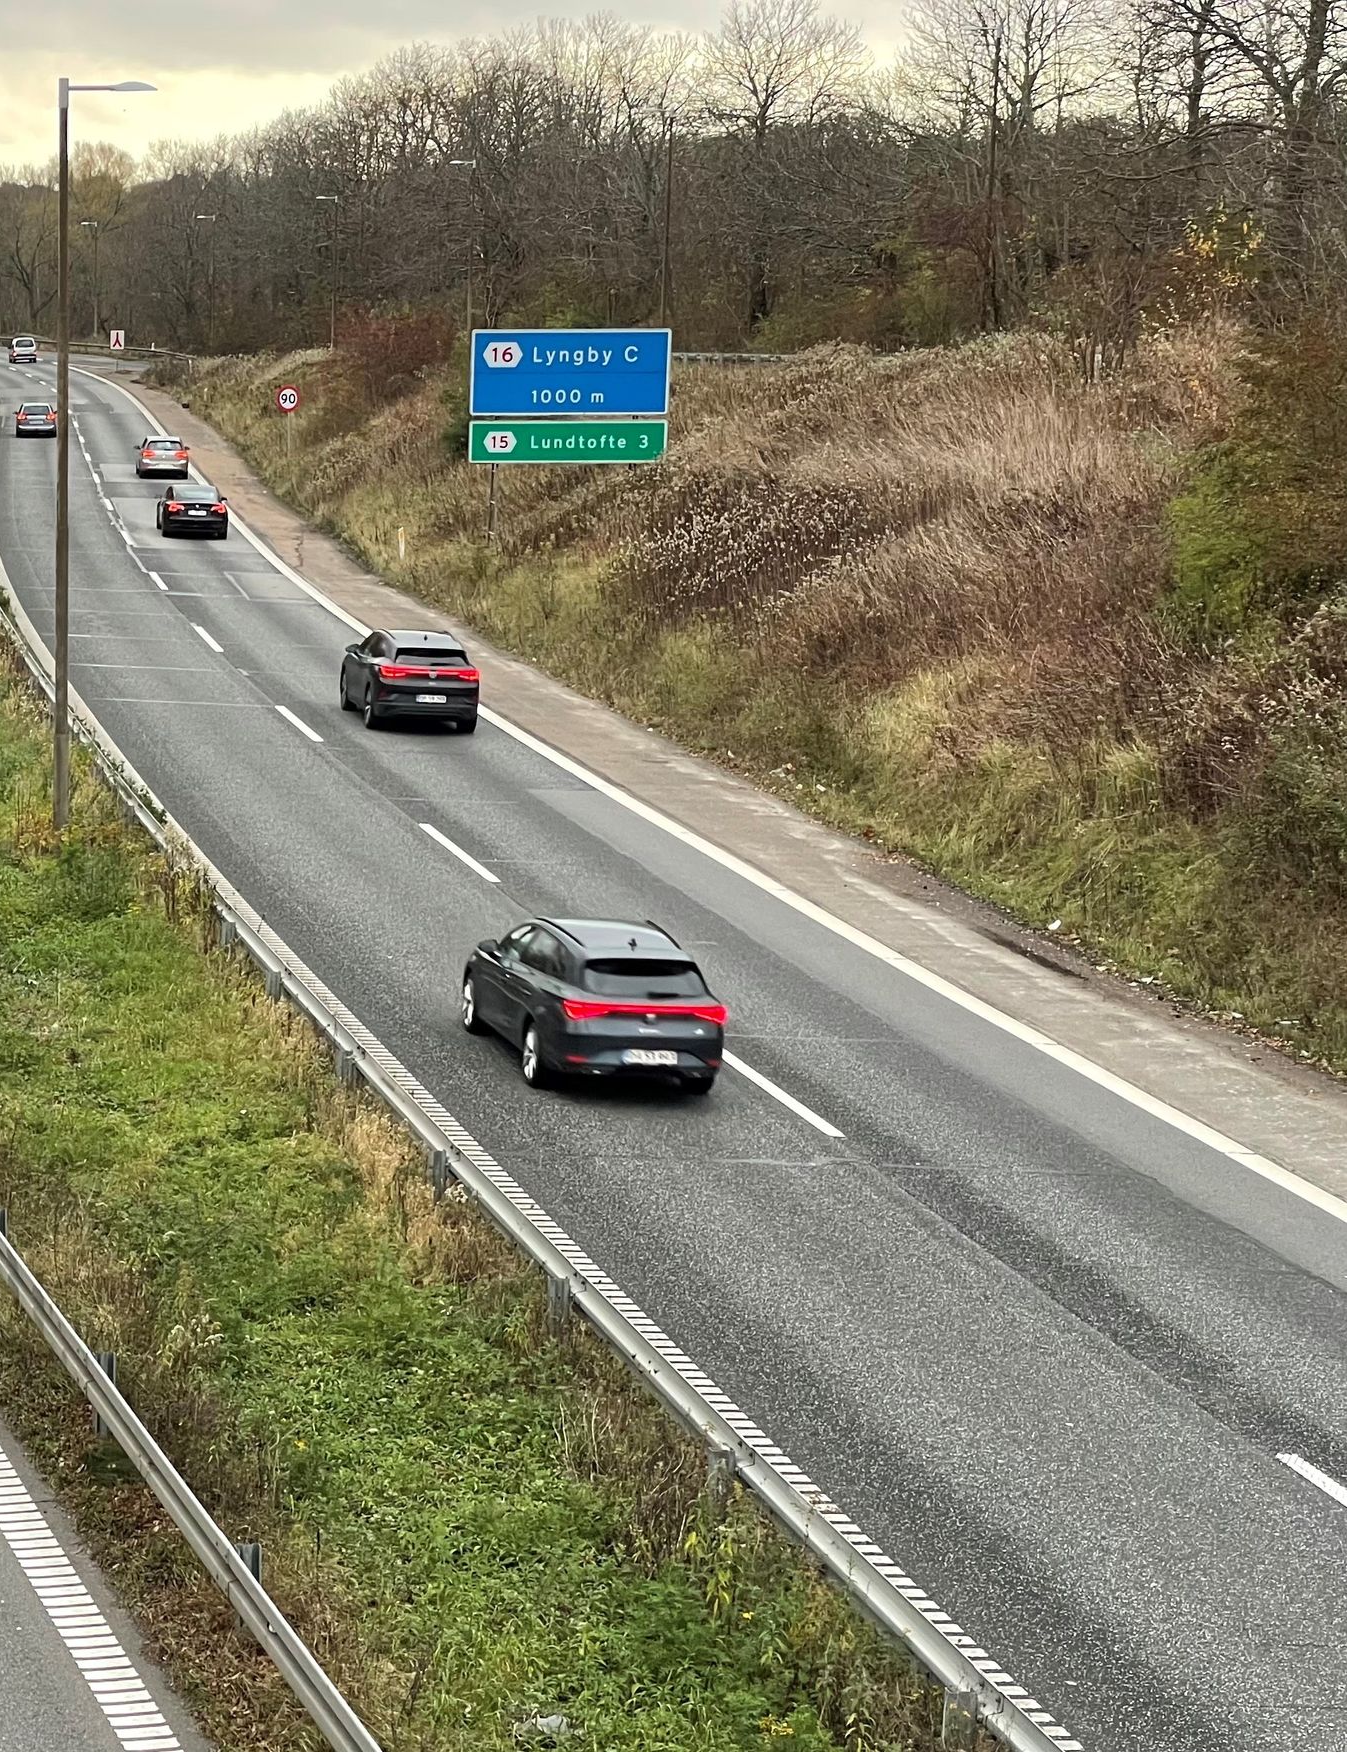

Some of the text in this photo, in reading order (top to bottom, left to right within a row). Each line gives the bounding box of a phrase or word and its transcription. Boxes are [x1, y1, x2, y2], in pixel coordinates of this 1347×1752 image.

[491, 345, 639, 366] 16 Lyngby C
[281, 393, 296, 404] 90
[531, 389, 605, 404] 1000 m
[490, 434, 650, 450] 15 Lundtofte 3
